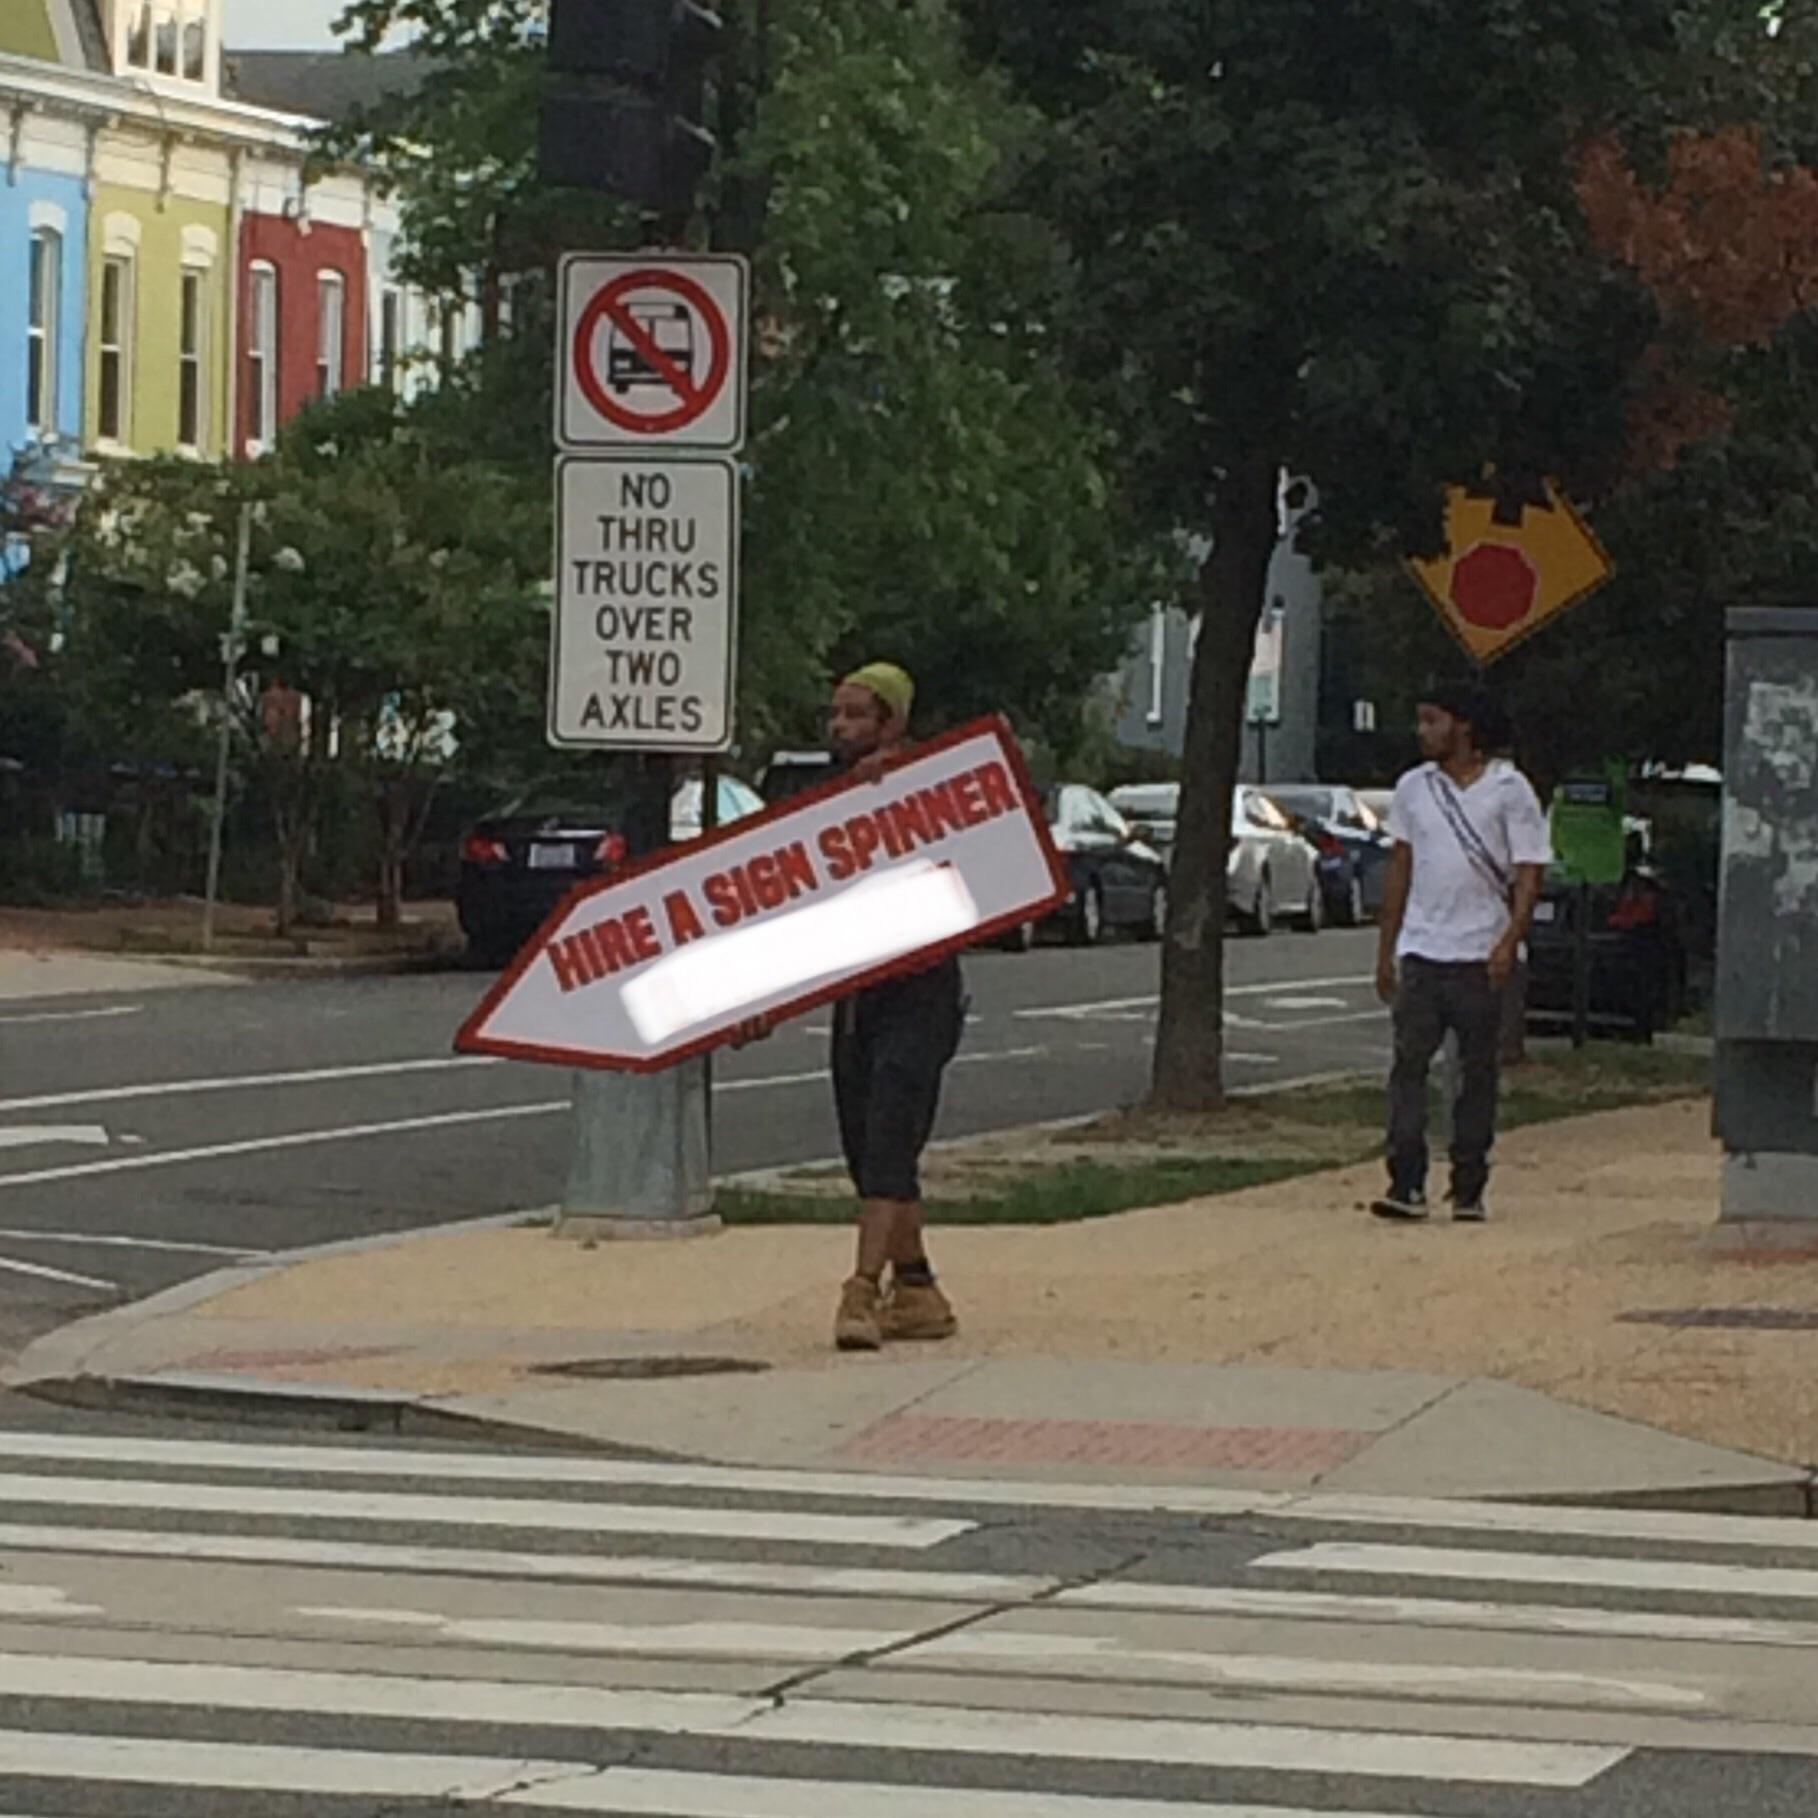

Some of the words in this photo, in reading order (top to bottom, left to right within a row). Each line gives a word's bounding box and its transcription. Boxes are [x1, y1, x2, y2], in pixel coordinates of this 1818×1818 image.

[620, 471, 672, 510] NO
[597, 514, 697, 555] THRU
[572, 559, 719, 600] TRUCKS
[595, 604, 693, 642] OVER
[604, 649, 681, 687] TWO
[580, 692, 702, 733] AXLES
[547, 904, 662, 992] HIRE
[662, 889, 705, 942] A
[702, 842, 818, 928] SIGN
[817, 760, 1019, 881] SPINNER
